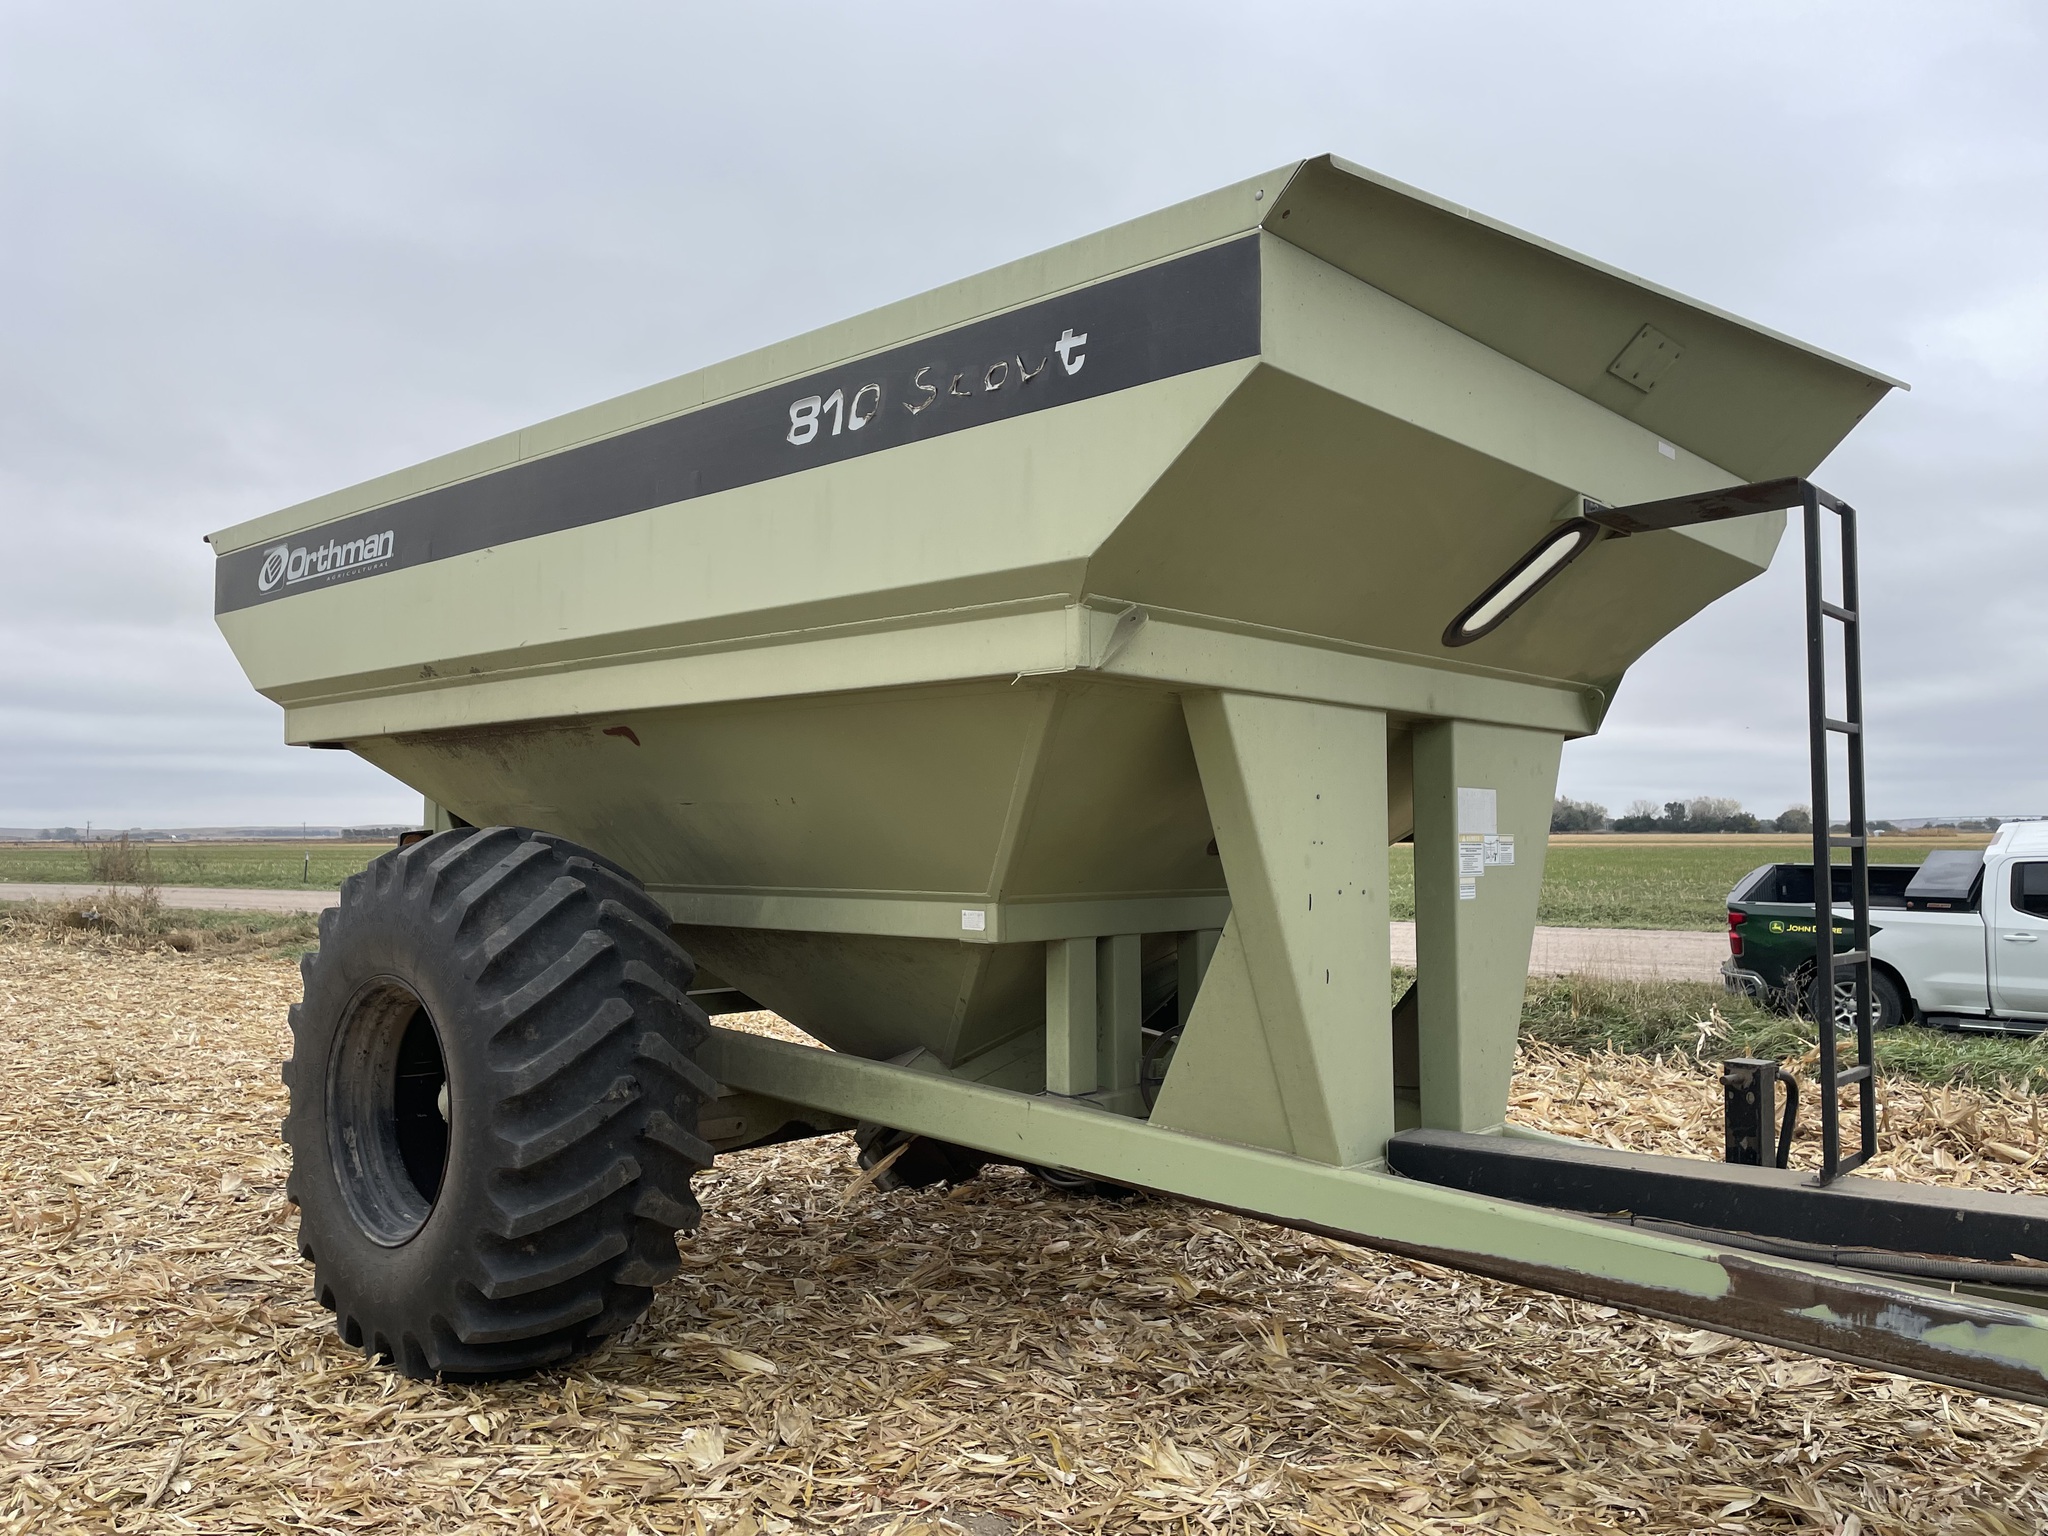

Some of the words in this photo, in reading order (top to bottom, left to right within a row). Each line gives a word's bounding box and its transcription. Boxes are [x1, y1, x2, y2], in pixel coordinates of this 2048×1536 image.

[786, 382, 881, 446] 810
[902, 328, 1088, 415] Scout
[287, 530, 394, 580] Orthman
[326, 561, 389, 582] AGRICULTURAL
[1786, 924, 1811, 933] JOHN
